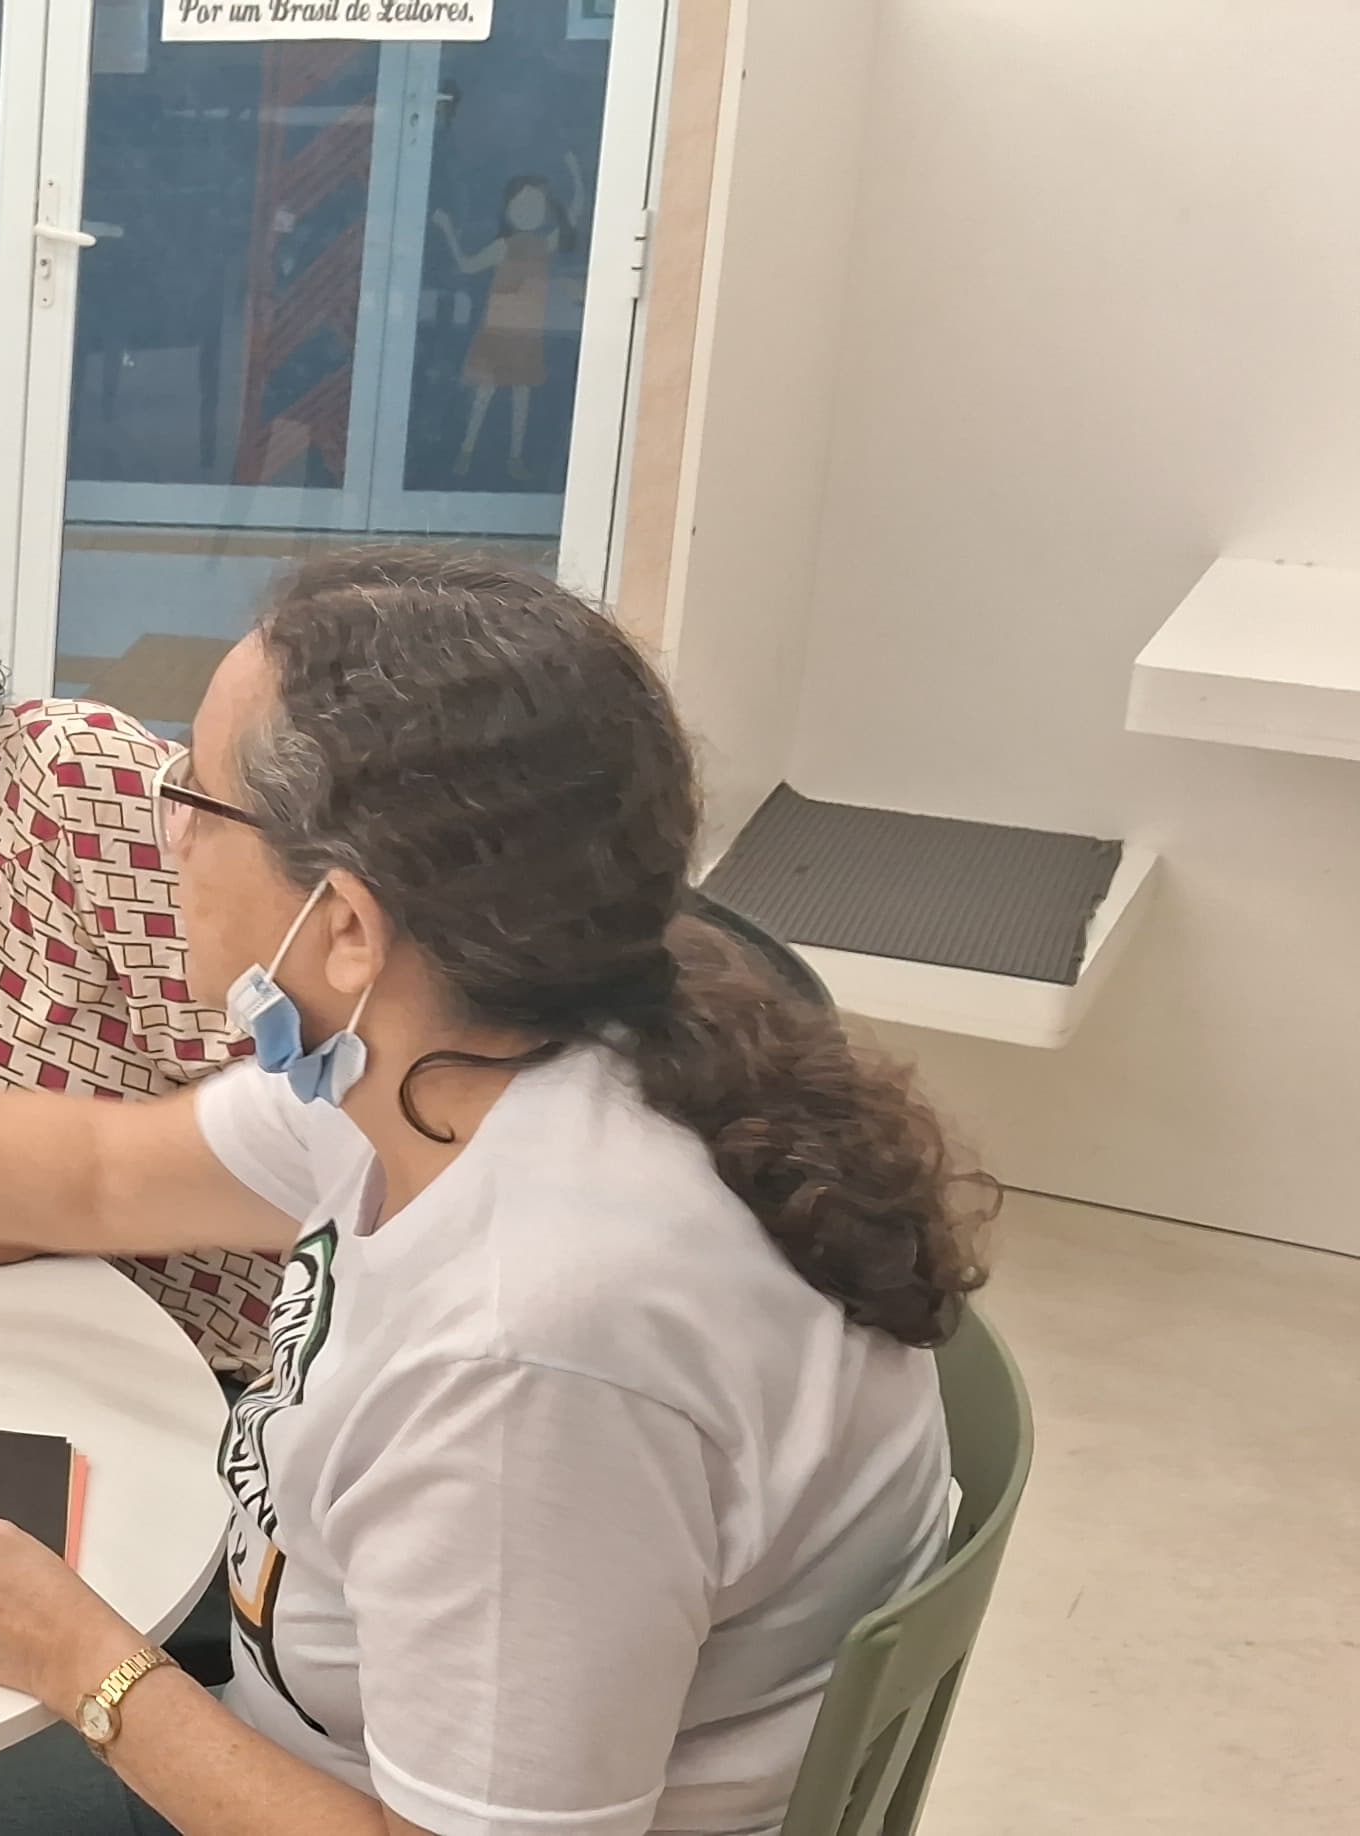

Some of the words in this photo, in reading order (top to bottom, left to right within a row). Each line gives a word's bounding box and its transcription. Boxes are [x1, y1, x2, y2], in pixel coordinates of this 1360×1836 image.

[178, 0, 223, 24] Por
[229, 4, 261, 22] um
[269, 0, 339, 22] Brasil
[345, 0, 371, 22] de
